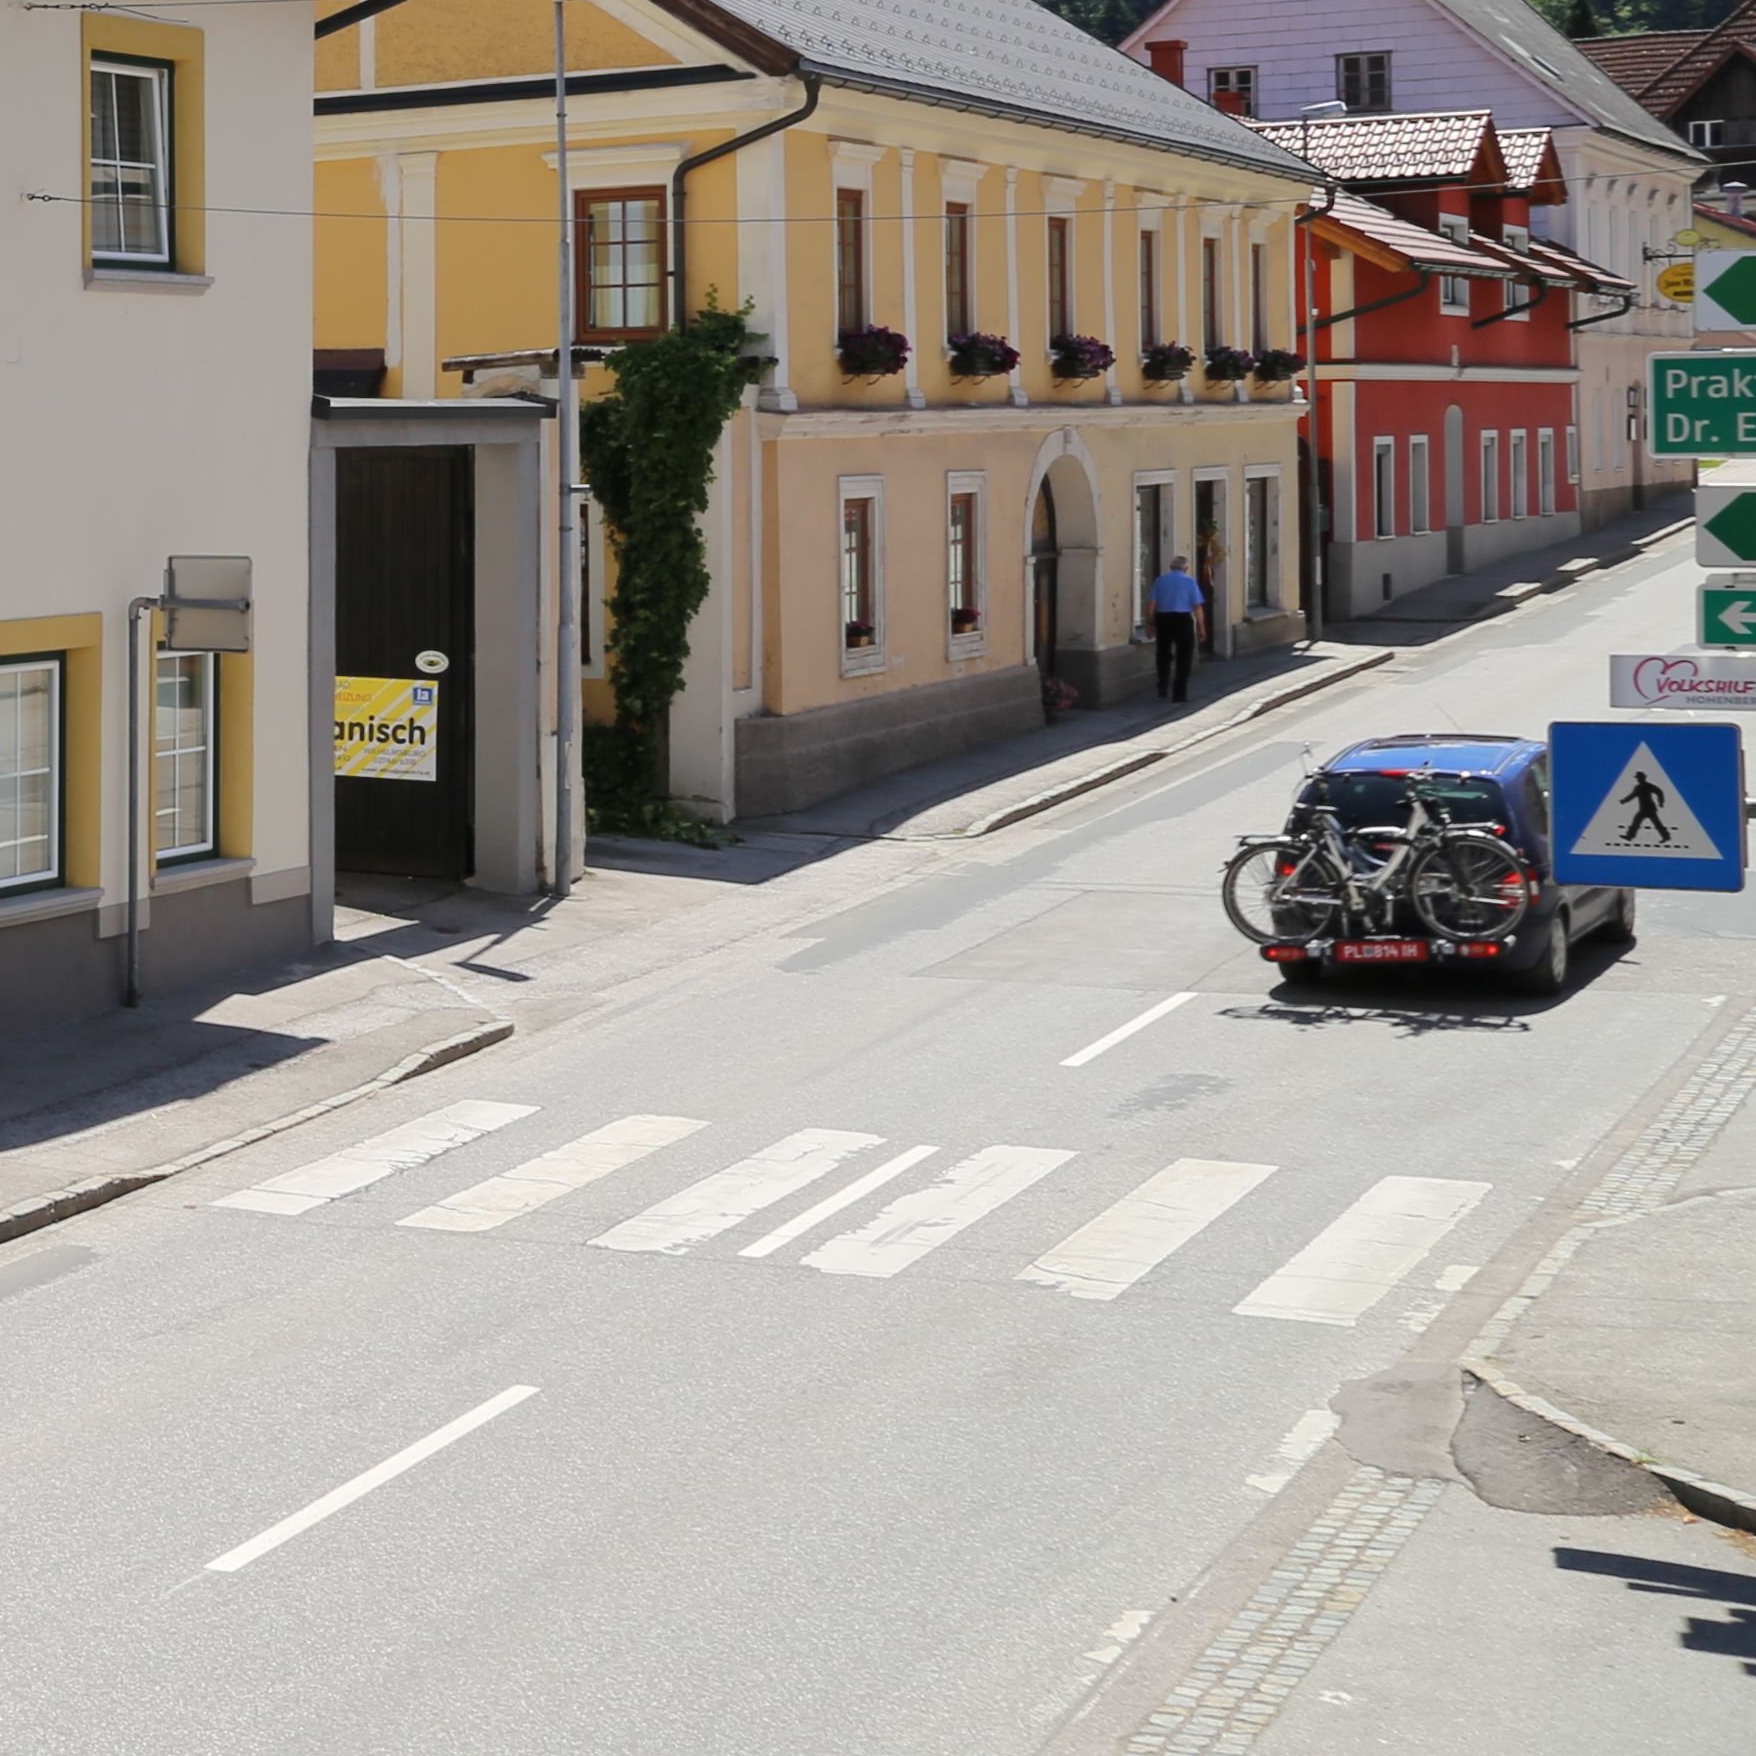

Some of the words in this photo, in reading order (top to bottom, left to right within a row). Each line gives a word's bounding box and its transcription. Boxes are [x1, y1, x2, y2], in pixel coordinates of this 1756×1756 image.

[1666, 369, 1756, 399] Prak
[1666, 413, 1719, 443] Dr.
[334, 715, 426, 746] anisch
